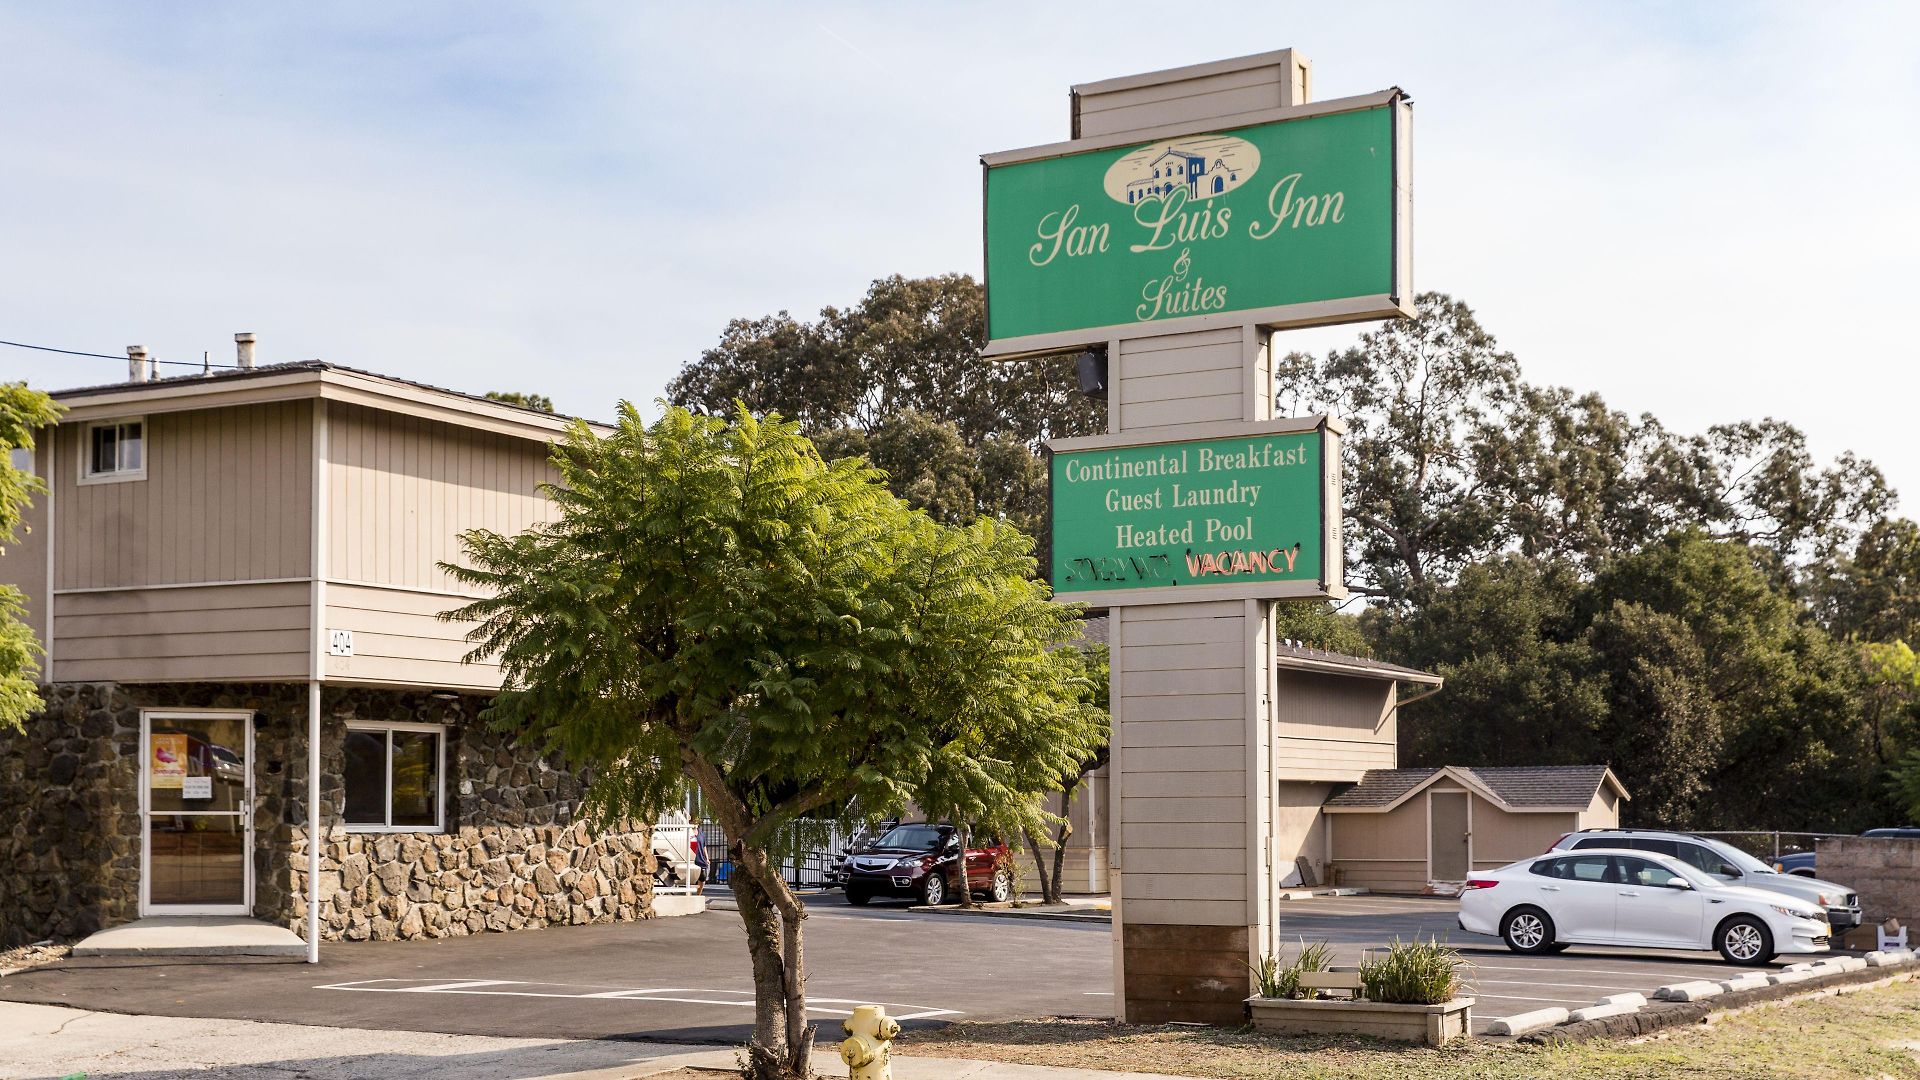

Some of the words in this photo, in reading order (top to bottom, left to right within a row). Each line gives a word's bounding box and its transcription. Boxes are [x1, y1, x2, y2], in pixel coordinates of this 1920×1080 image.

[1029, 204, 1110, 267] San
[1130, 186, 1233, 253] Luis
[1248, 172, 1346, 241] Inn
[1172, 247, 1191, 282] &
[1135, 276, 1229, 322] Suites
[1065, 450, 1188, 483] Continental
[1198, 442, 1307, 473] Breakfast
[1105, 488, 1163, 513] Guest
[1171, 479, 1262, 508] Laundry
[1115, 520, 1194, 549] Heated
[1205, 516, 1254, 543] Pool
[1184, 544, 1299, 578] VACANCY
[332, 631, 351, 654] 404
